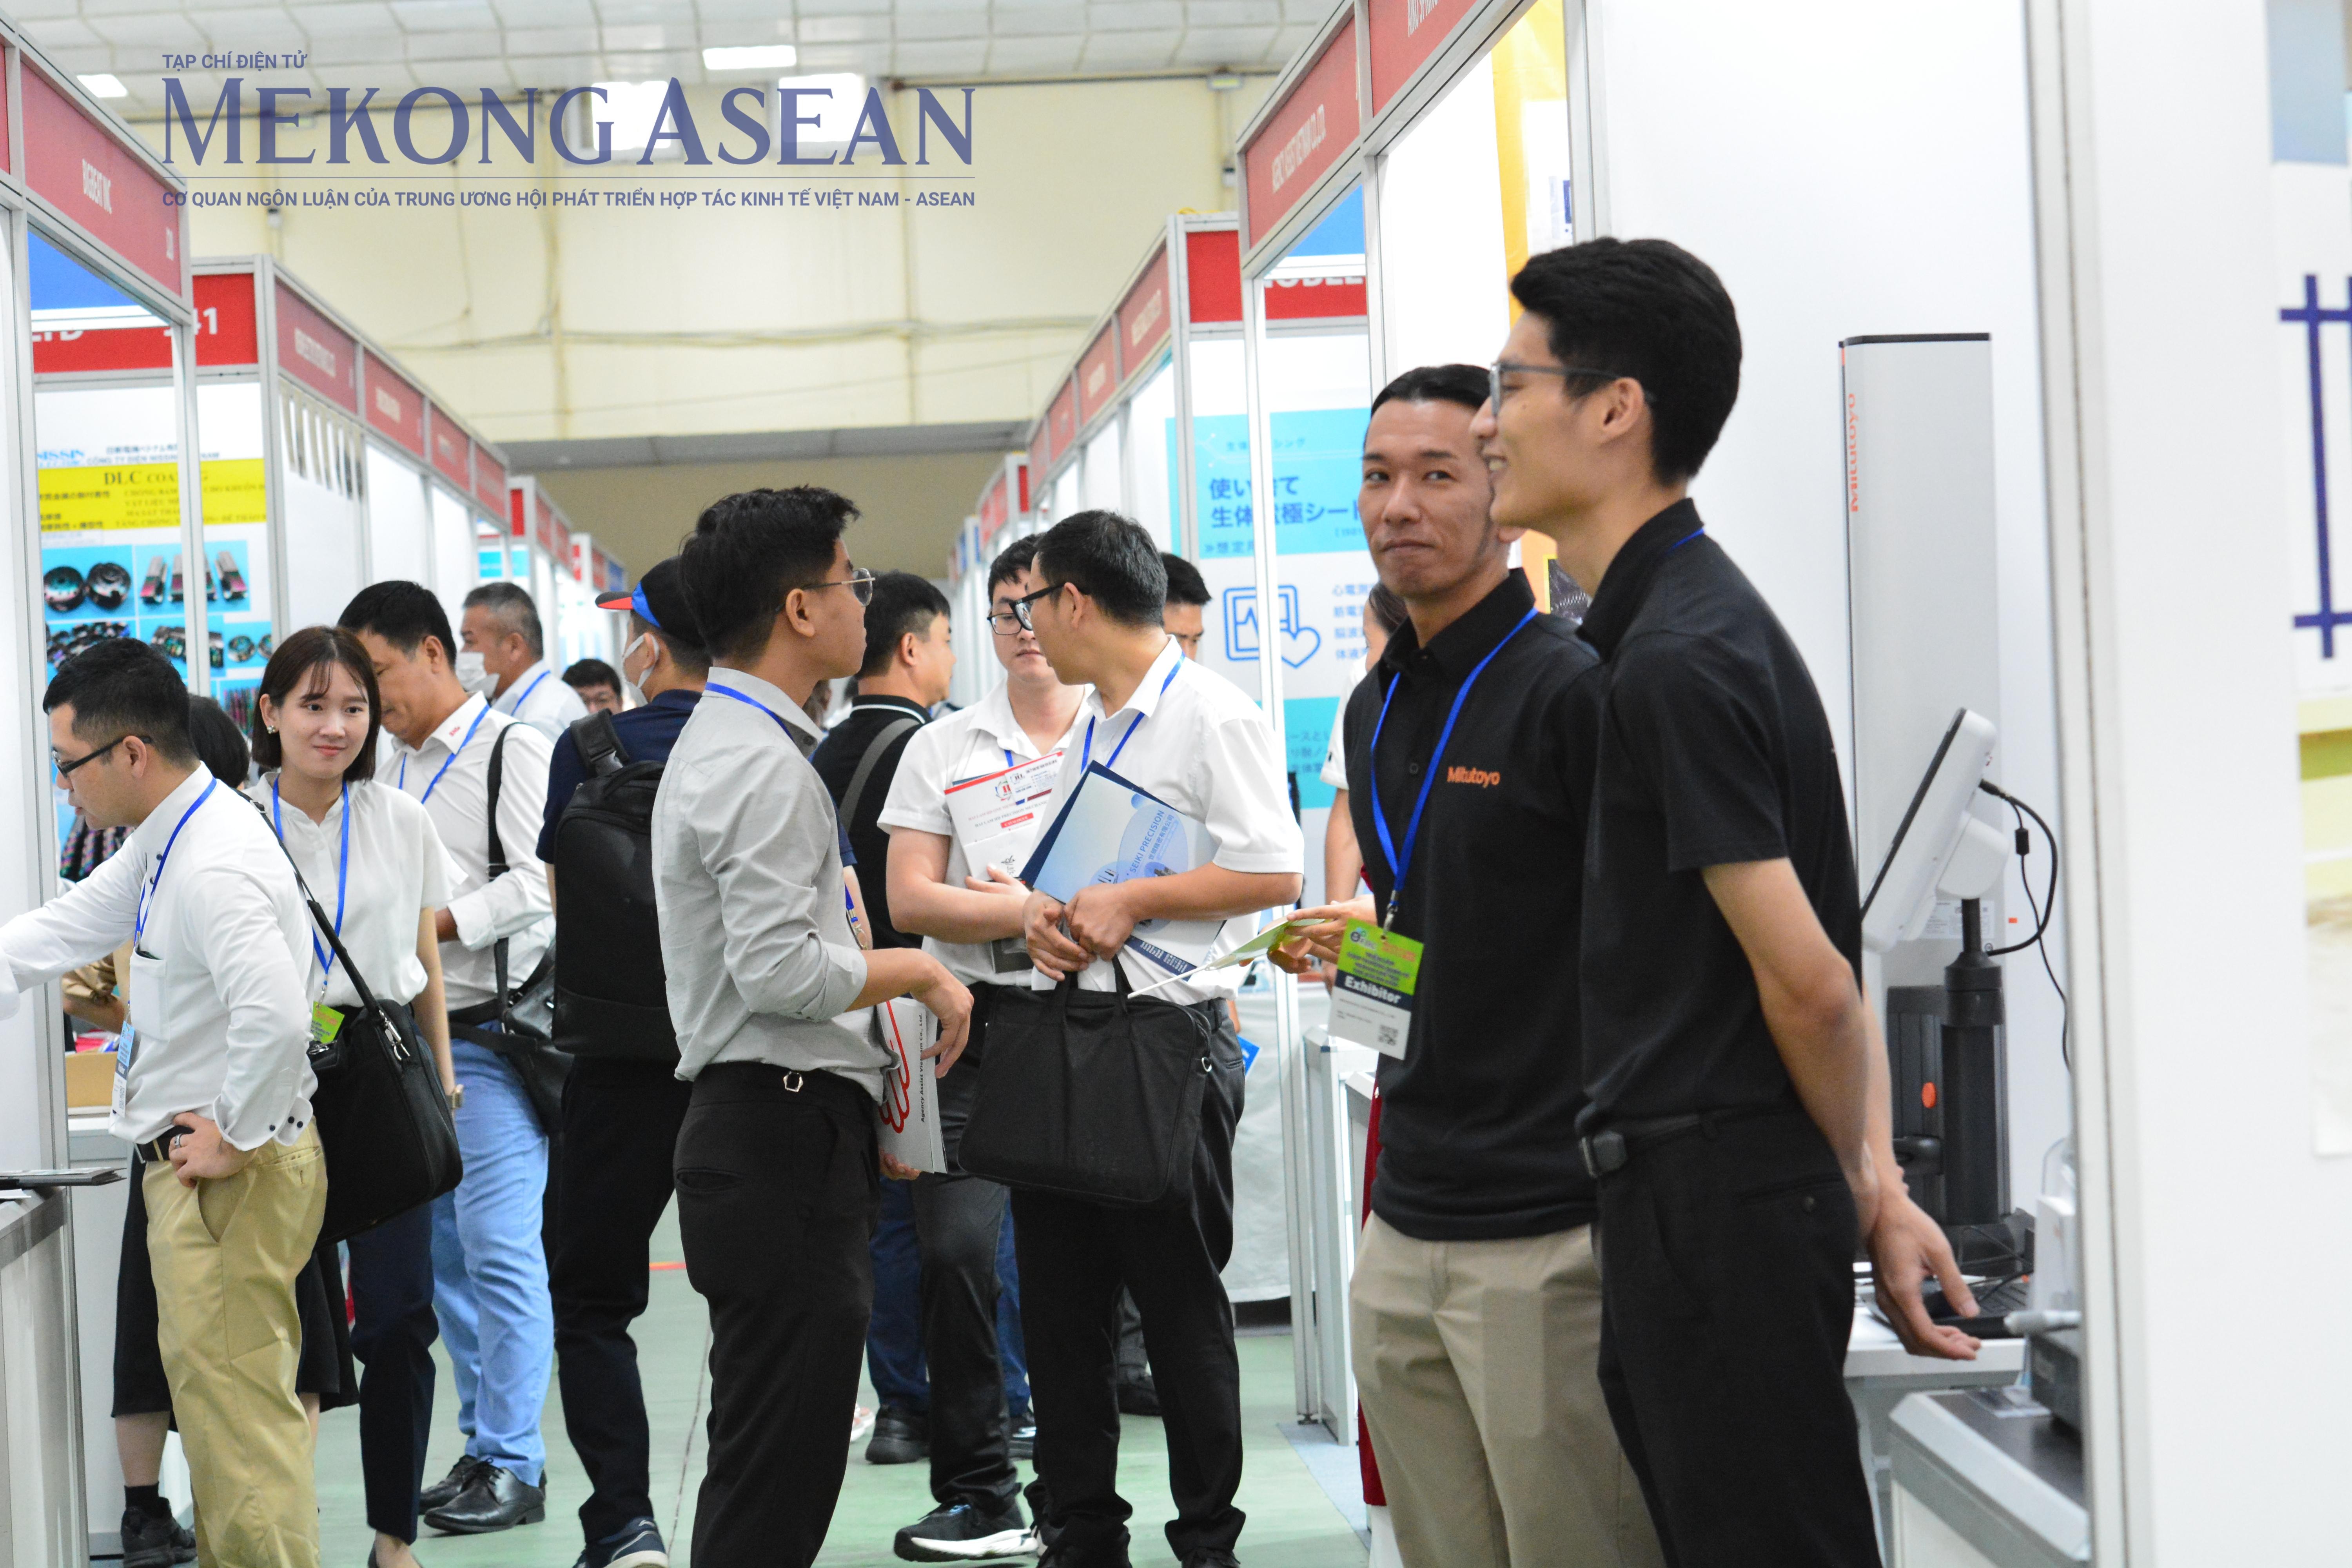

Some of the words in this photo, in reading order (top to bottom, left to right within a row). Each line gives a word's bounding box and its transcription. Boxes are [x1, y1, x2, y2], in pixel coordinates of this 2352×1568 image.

[1848, 393, 1859, 513] Mitutoyo
[104, 471, 143, 485] DLC
[1210, 475, 1299, 500] 使いて
[1211, 499, 1359, 528] 生体極シー
[1447, 766, 1501, 788] Mitutoyo
[1001, 808, 1024, 818] PRECISION
[1129, 853, 1144, 873] SEIKI
[1140, 810, 1165, 852] PRECISION
[1344, 975, 1402, 1004] Exhibitor
